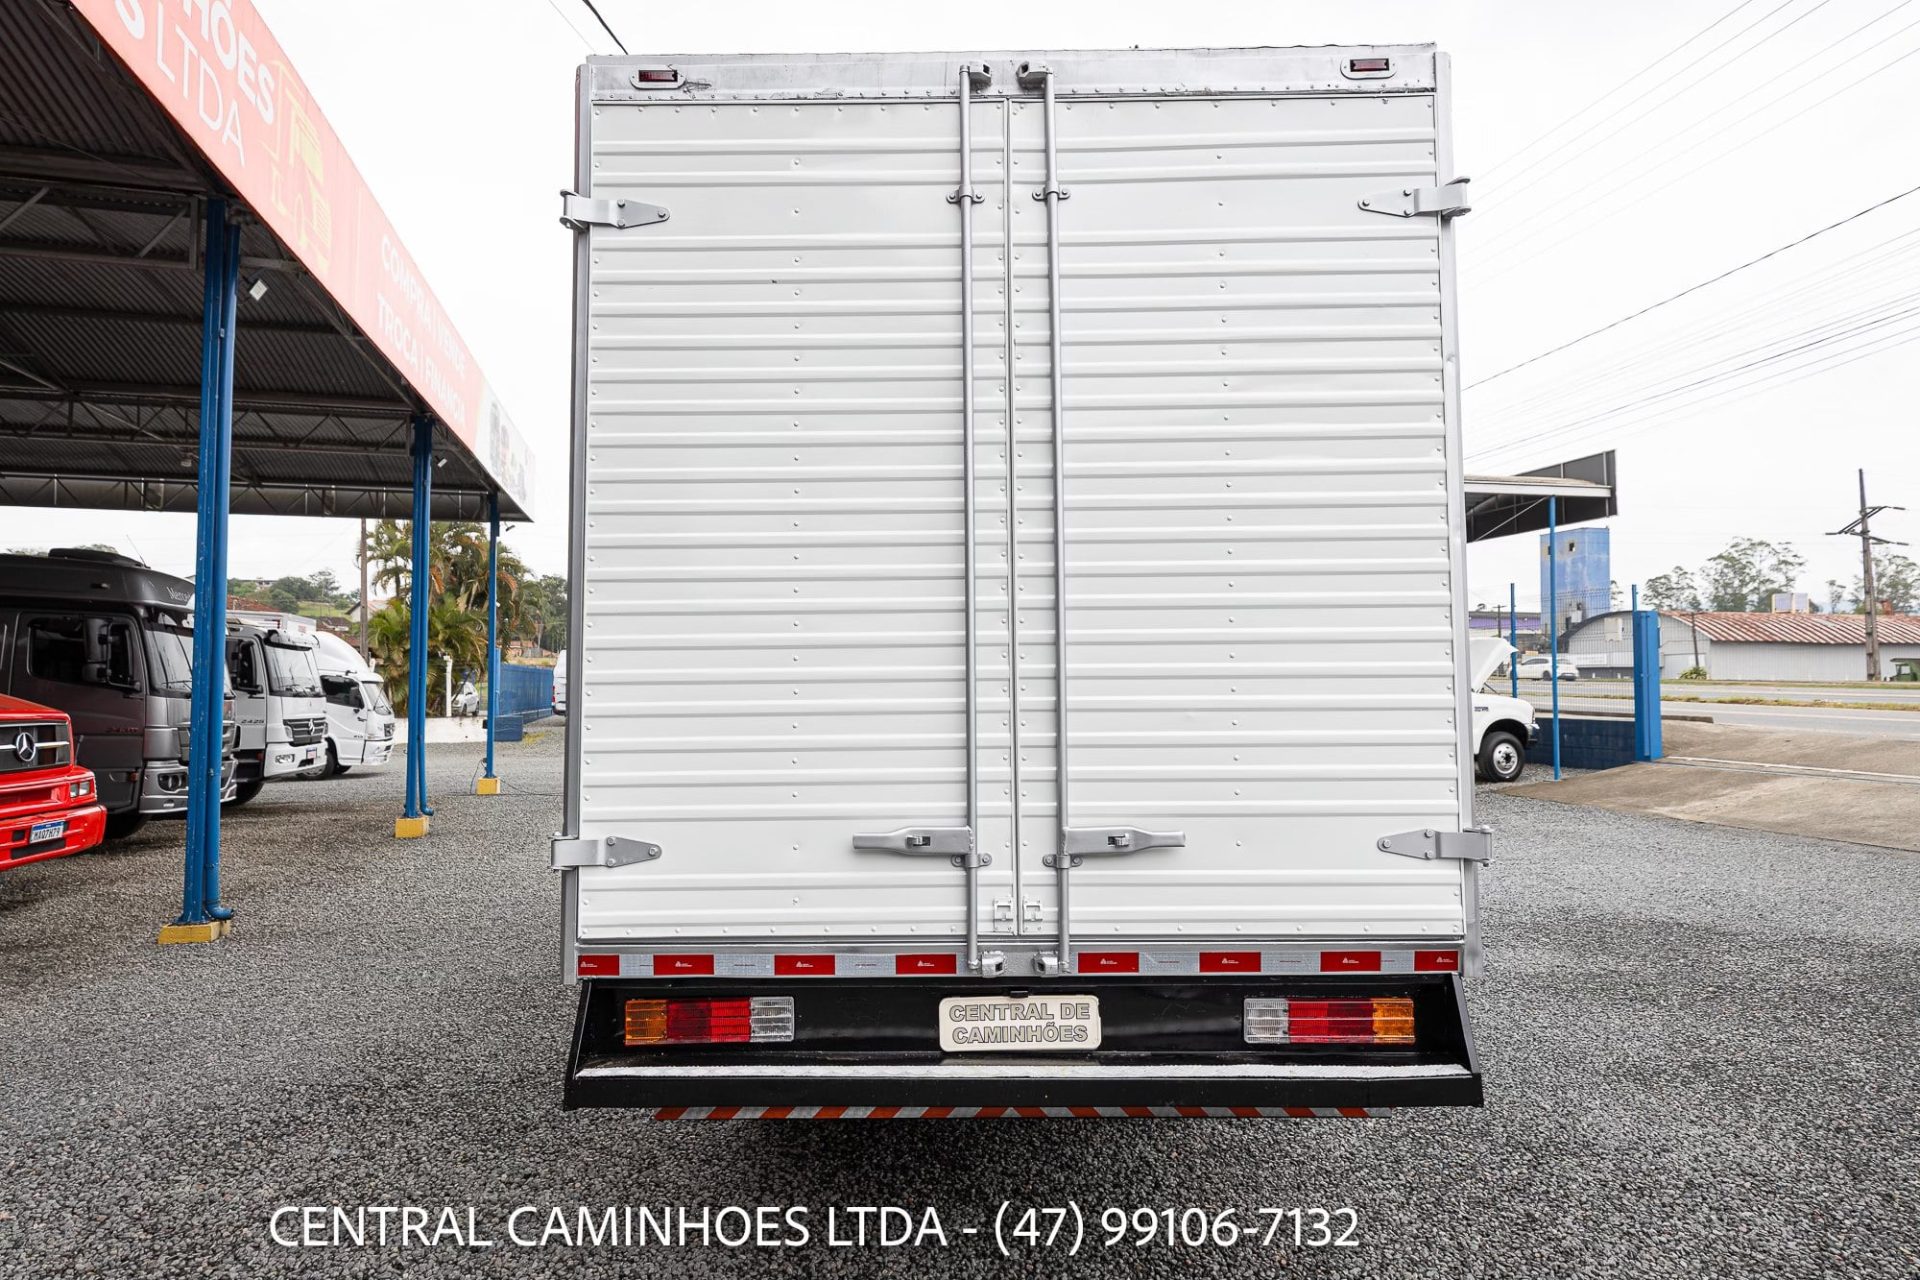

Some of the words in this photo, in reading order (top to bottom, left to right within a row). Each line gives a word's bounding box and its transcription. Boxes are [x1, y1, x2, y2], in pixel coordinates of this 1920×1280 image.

[156, 2, 245, 168] LTDA
[376, 290, 419, 373] TROCA
[381, 232, 432, 333] COMPRA
[437, 315, 466, 382] VENDE
[949, 1002, 1054, 1022] CENTRAL
[1060, 1002, 1090, 1020] DE
[952, 1021, 1088, 1044] CAMINHÕES
